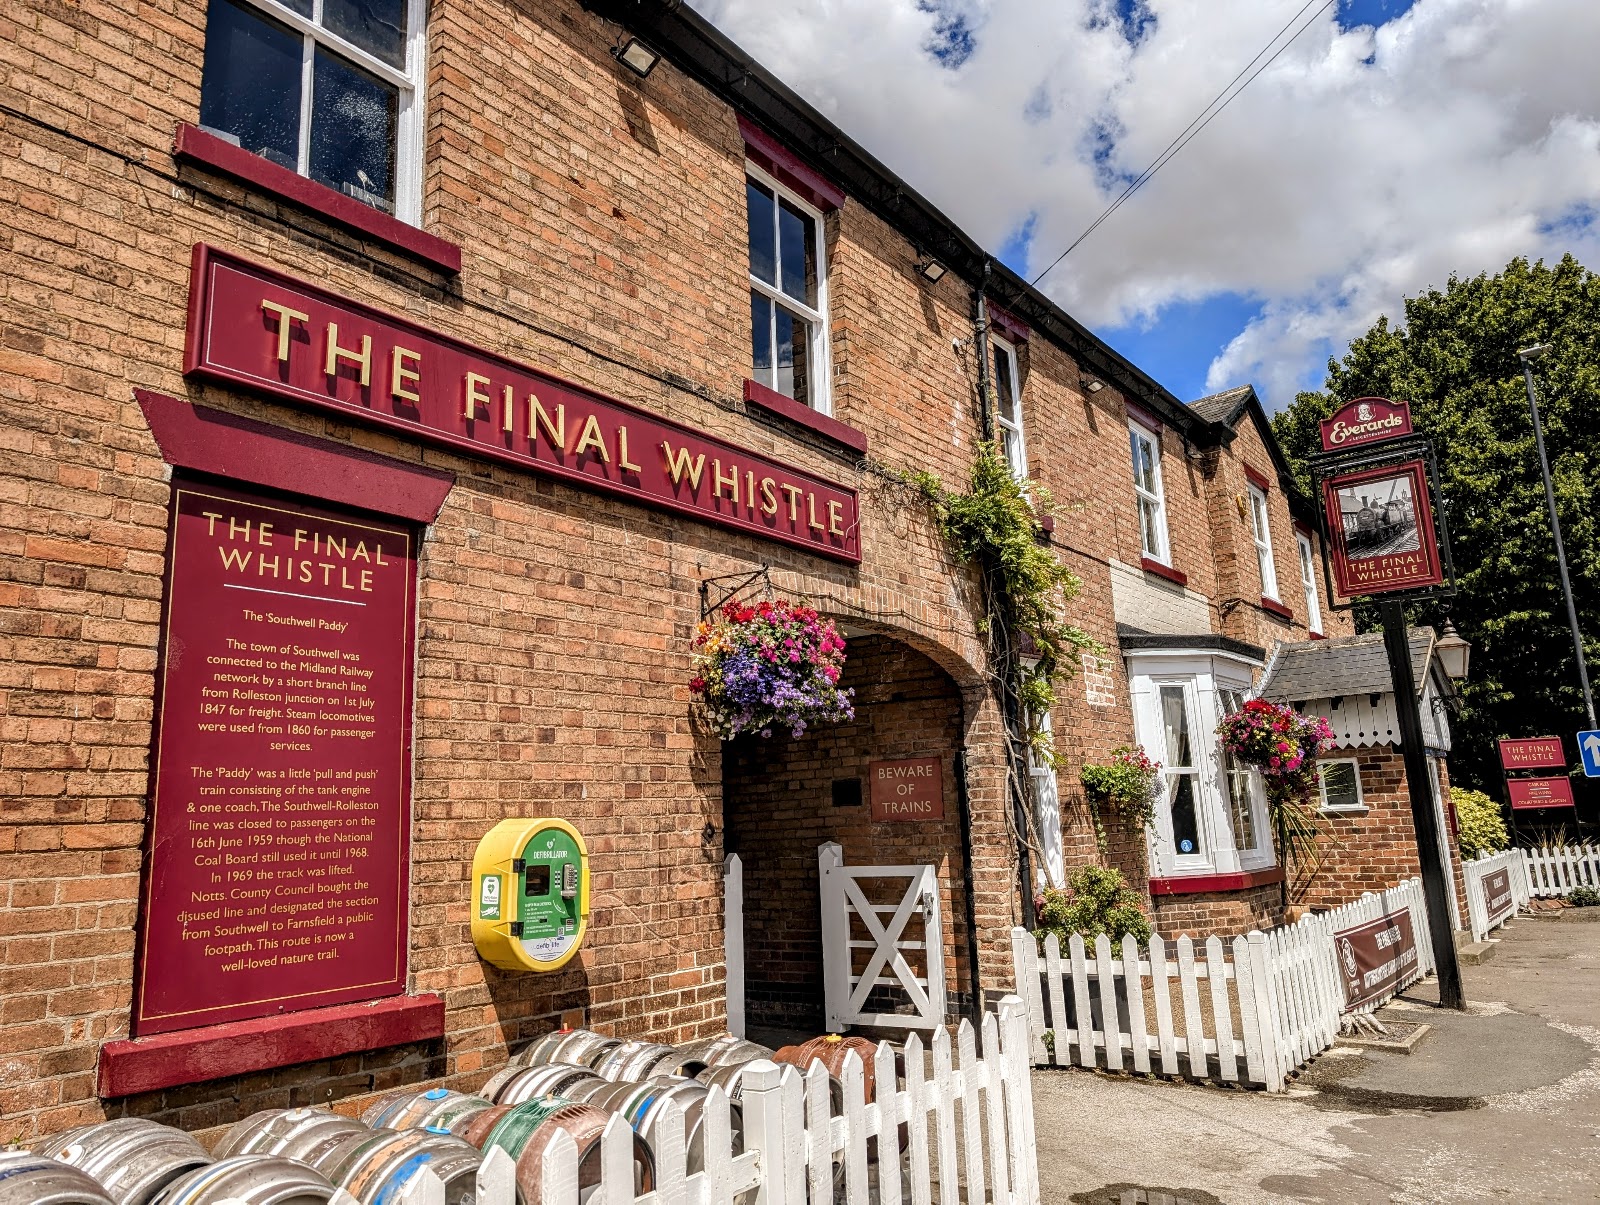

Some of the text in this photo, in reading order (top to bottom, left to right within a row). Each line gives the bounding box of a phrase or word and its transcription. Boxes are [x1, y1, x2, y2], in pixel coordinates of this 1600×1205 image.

[261, 298, 844, 536] THE FINAL WHISTLE
[1330, 413, 1403, 443] Everards
[202, 511, 389, 566] THE FINAL
[218, 545, 373, 592] WHISTLE
[1350, 553, 1423, 572] THE FINAL
[1356, 564, 1418, 581] WHISTLE
[243, 609, 263, 622] The
[226, 638, 360, 661] The town of Southwell was
[207, 656, 374, 680] connected to the Midland Railway
[214, 673, 259, 684] network
[262, 674, 275, 687] by
[286, 677, 313, 688] short
[316, 679, 348, 690] branch
[351, 682, 367, 692] line
[202, 686, 229, 698] from
[233, 688, 281, 701] Rolleston
[285, 693, 324, 705] junction
[344, 696, 357, 706] 1st
[358, 697, 375, 710] July
[200, 703, 375, 722] 1847 for freight. Steam locomotives
[198, 723, 376, 740] were used from 1860 for passenger
[270, 741, 313, 751] services.
[1506, 745, 1556, 754] THE FINAL
[1511, 753, 1554, 761] WHISTLE
[191, 767, 213, 778] The
[289, 768, 311, 778] little
[335, 769, 352, 779] and
[878, 765, 933, 779] BEWARE
[200, 784, 370, 797] train consisting of the tank engine
[896, 783, 915, 795] OF
[187, 800, 379, 813] & one coach, The Southwell-Rolleston
[882, 800, 932, 813] TRAINS
[189, 819, 209, 830] line
[213, 822, 234, 830] was
[238, 818, 272, 829] closed
[276, 820, 287, 828] to
[291, 819, 343, 830] passengers
[361, 816, 376, 825] the
[191, 831, 373, 850] 16th June 1959 though the National
[195, 847, 369, 866] Coal Board still used it until 1968.
[533, 850, 568, 860] DEFIBRILLATOR
[211, 872, 221, 883] In
[228, 870, 253, 882] 1969
[256, 869, 273, 880] the
[277, 867, 303, 878] track
[329, 864, 354, 875] lifted.
[191, 880, 369, 902] Notts. County Council bought the
[177, 896, 378, 922] disused line and designated the section
[182, 929, 210, 940] from
[214, 921, 268, 937] Southwell
[287, 915, 335, 929] Farnsfield
[346, 912, 373, 926] public
[205, 941, 255, 956] footpath.
[256, 938, 279, 950] This
[283, 937, 310, 947] route
[314, 934, 321, 943] is
[325, 933, 346, 942] now
[221, 948, 339, 972] well-loved nature trail.
